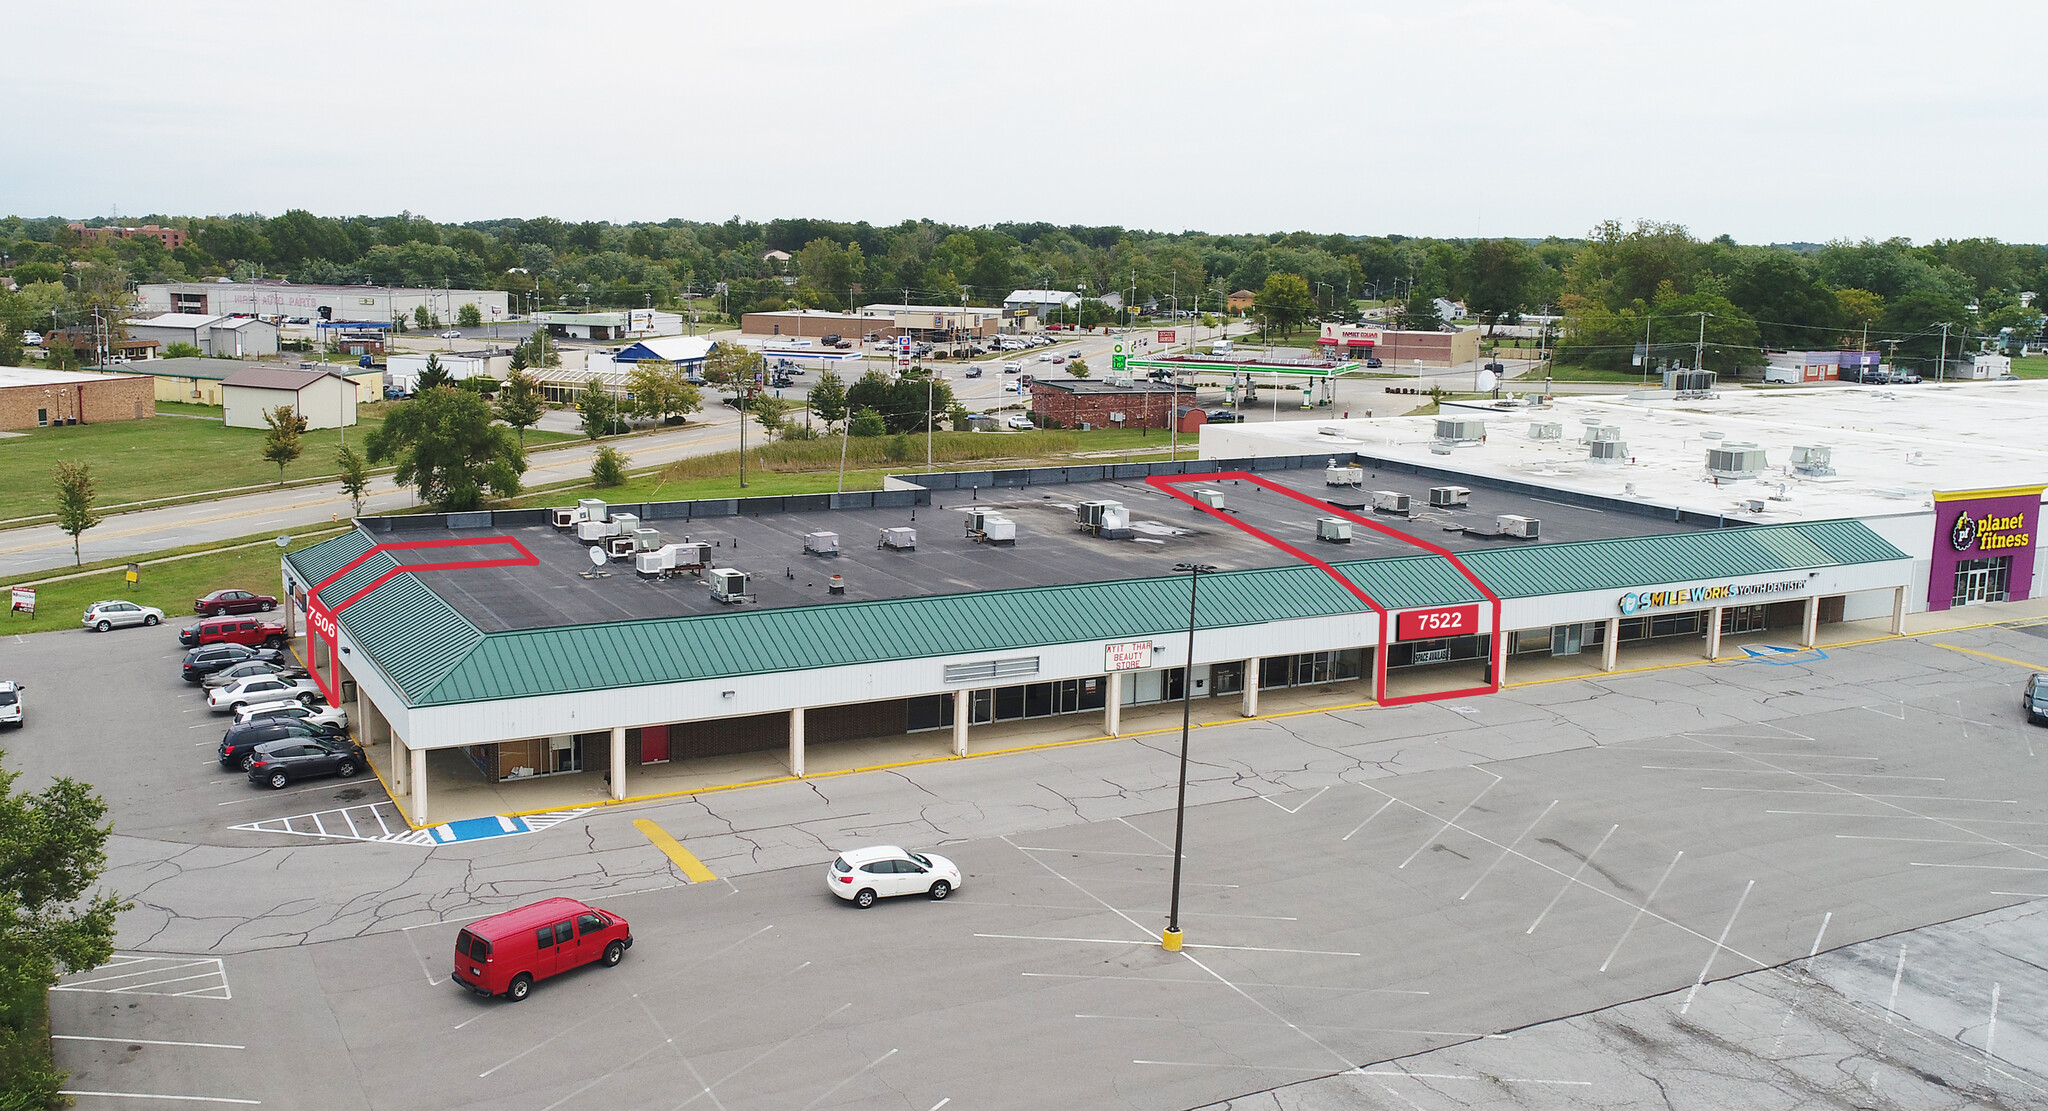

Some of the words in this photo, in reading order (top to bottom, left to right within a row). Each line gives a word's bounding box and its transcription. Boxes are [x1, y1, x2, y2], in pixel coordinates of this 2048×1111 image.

[289, 297, 317, 307] PARTS
[1976, 512, 2024, 537] planet
[1980, 531, 2029, 550] fitness
[1640, 589, 1687, 610] SMILE
[1690, 583, 1737, 602] WORKS
[1738, 583, 1766, 596] YOUTH
[1766, 580, 1807, 593] DENTISTRY
[1132, 641, 1151, 651] THAR
[1114, 652, 1143, 662] BEAUTY
[1415, 652, 1429, 662] SPACE
[1115, 660, 1140, 670] STORE
